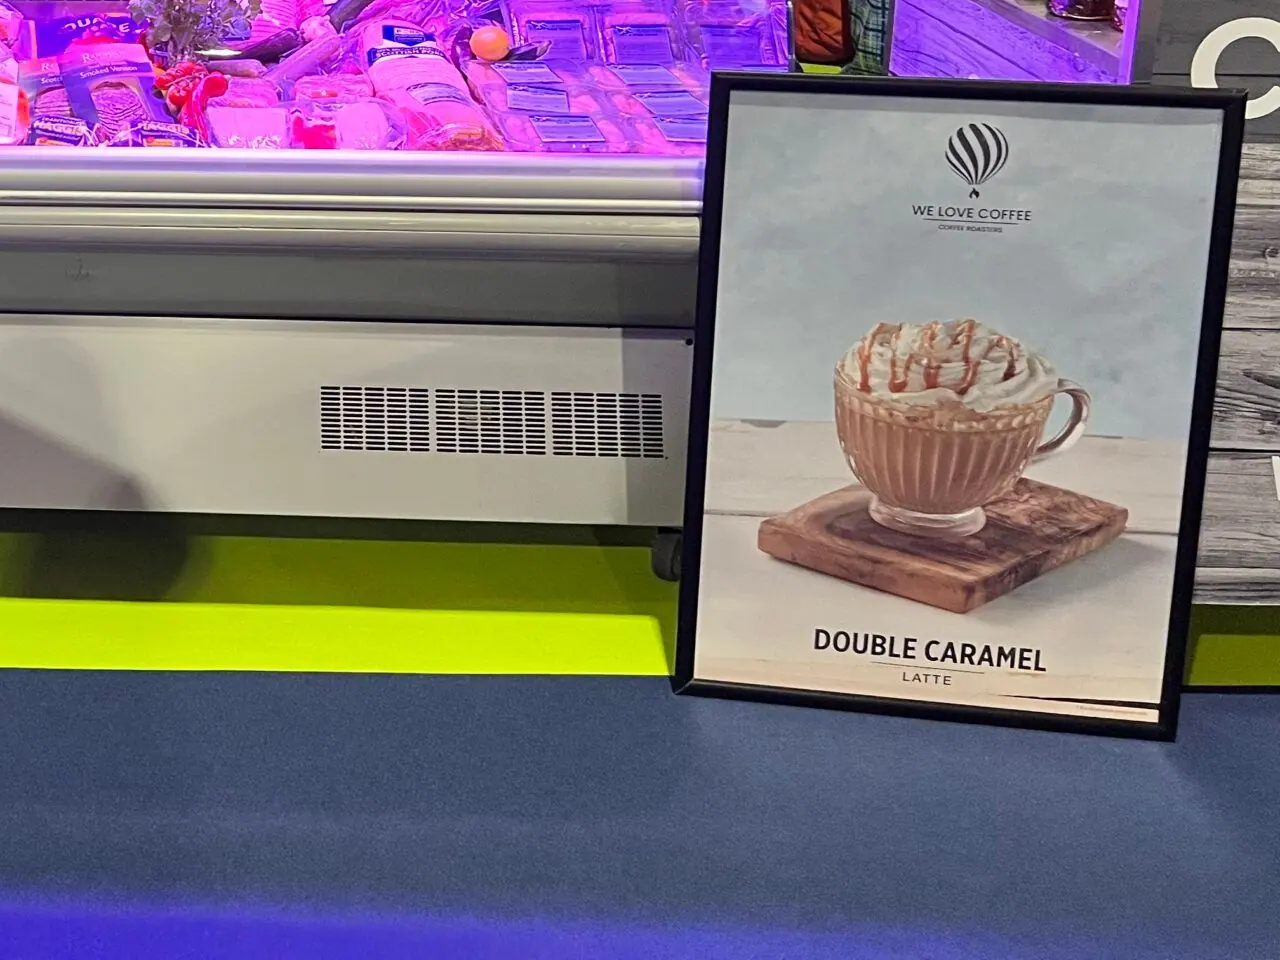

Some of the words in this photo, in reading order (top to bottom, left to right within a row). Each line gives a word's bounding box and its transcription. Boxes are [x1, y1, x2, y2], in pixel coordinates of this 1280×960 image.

[80, 66, 109, 79] Smoked
[110, 64, 138, 73] Venison
[912, 205, 934, 216] WE
[938, 206, 974, 219] LOVE
[978, 208, 1032, 221] COFFEE
[814, 628, 918, 660] DOUBLE
[924, 639, 1047, 672] CARAMEL
[903, 671, 952, 686] LATTE
